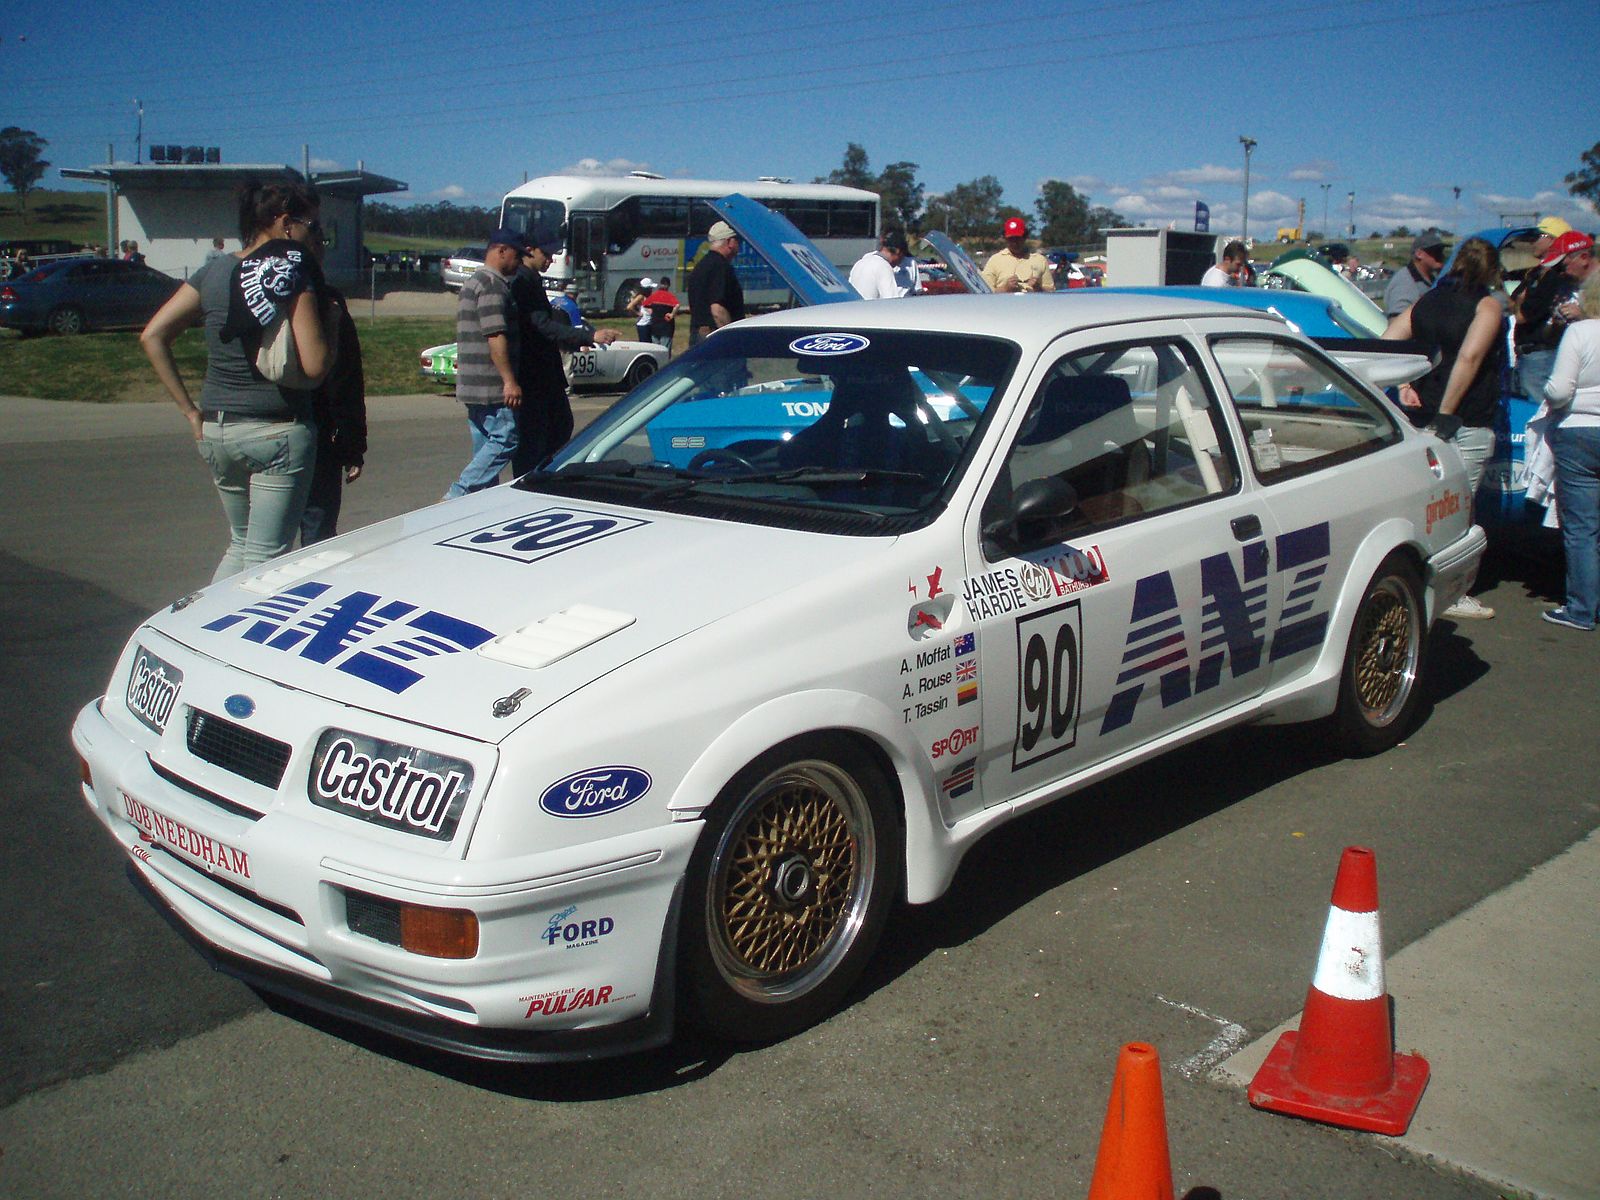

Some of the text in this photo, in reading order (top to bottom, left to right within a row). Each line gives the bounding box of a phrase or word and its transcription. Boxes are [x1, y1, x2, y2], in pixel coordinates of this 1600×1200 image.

[803, 336, 852, 352] Ford
[571, 355, 595, 374] 295
[470, 513, 618, 552] 90
[963, 568, 1019, 601] JAMES
[966, 588, 1028, 622] HARDIE
[900, 645, 951, 676] A. Moffat
[128, 656, 182, 728] Castrol
[902, 671, 952, 700] A. Rouse
[1022, 623, 1077, 752] 90
[903, 695, 948, 724] T. Tassin
[318, 739, 463, 831] Castrol
[565, 773, 629, 810] Ford
[152, 811, 251, 879] NEEDHAM
[548, 916, 615, 946] FORD
[566, 938, 599, 950] MAGAZINE
[518, 987, 576, 1002] MAINTENANCE FREE
[524, 984, 614, 1019] PULSAR
